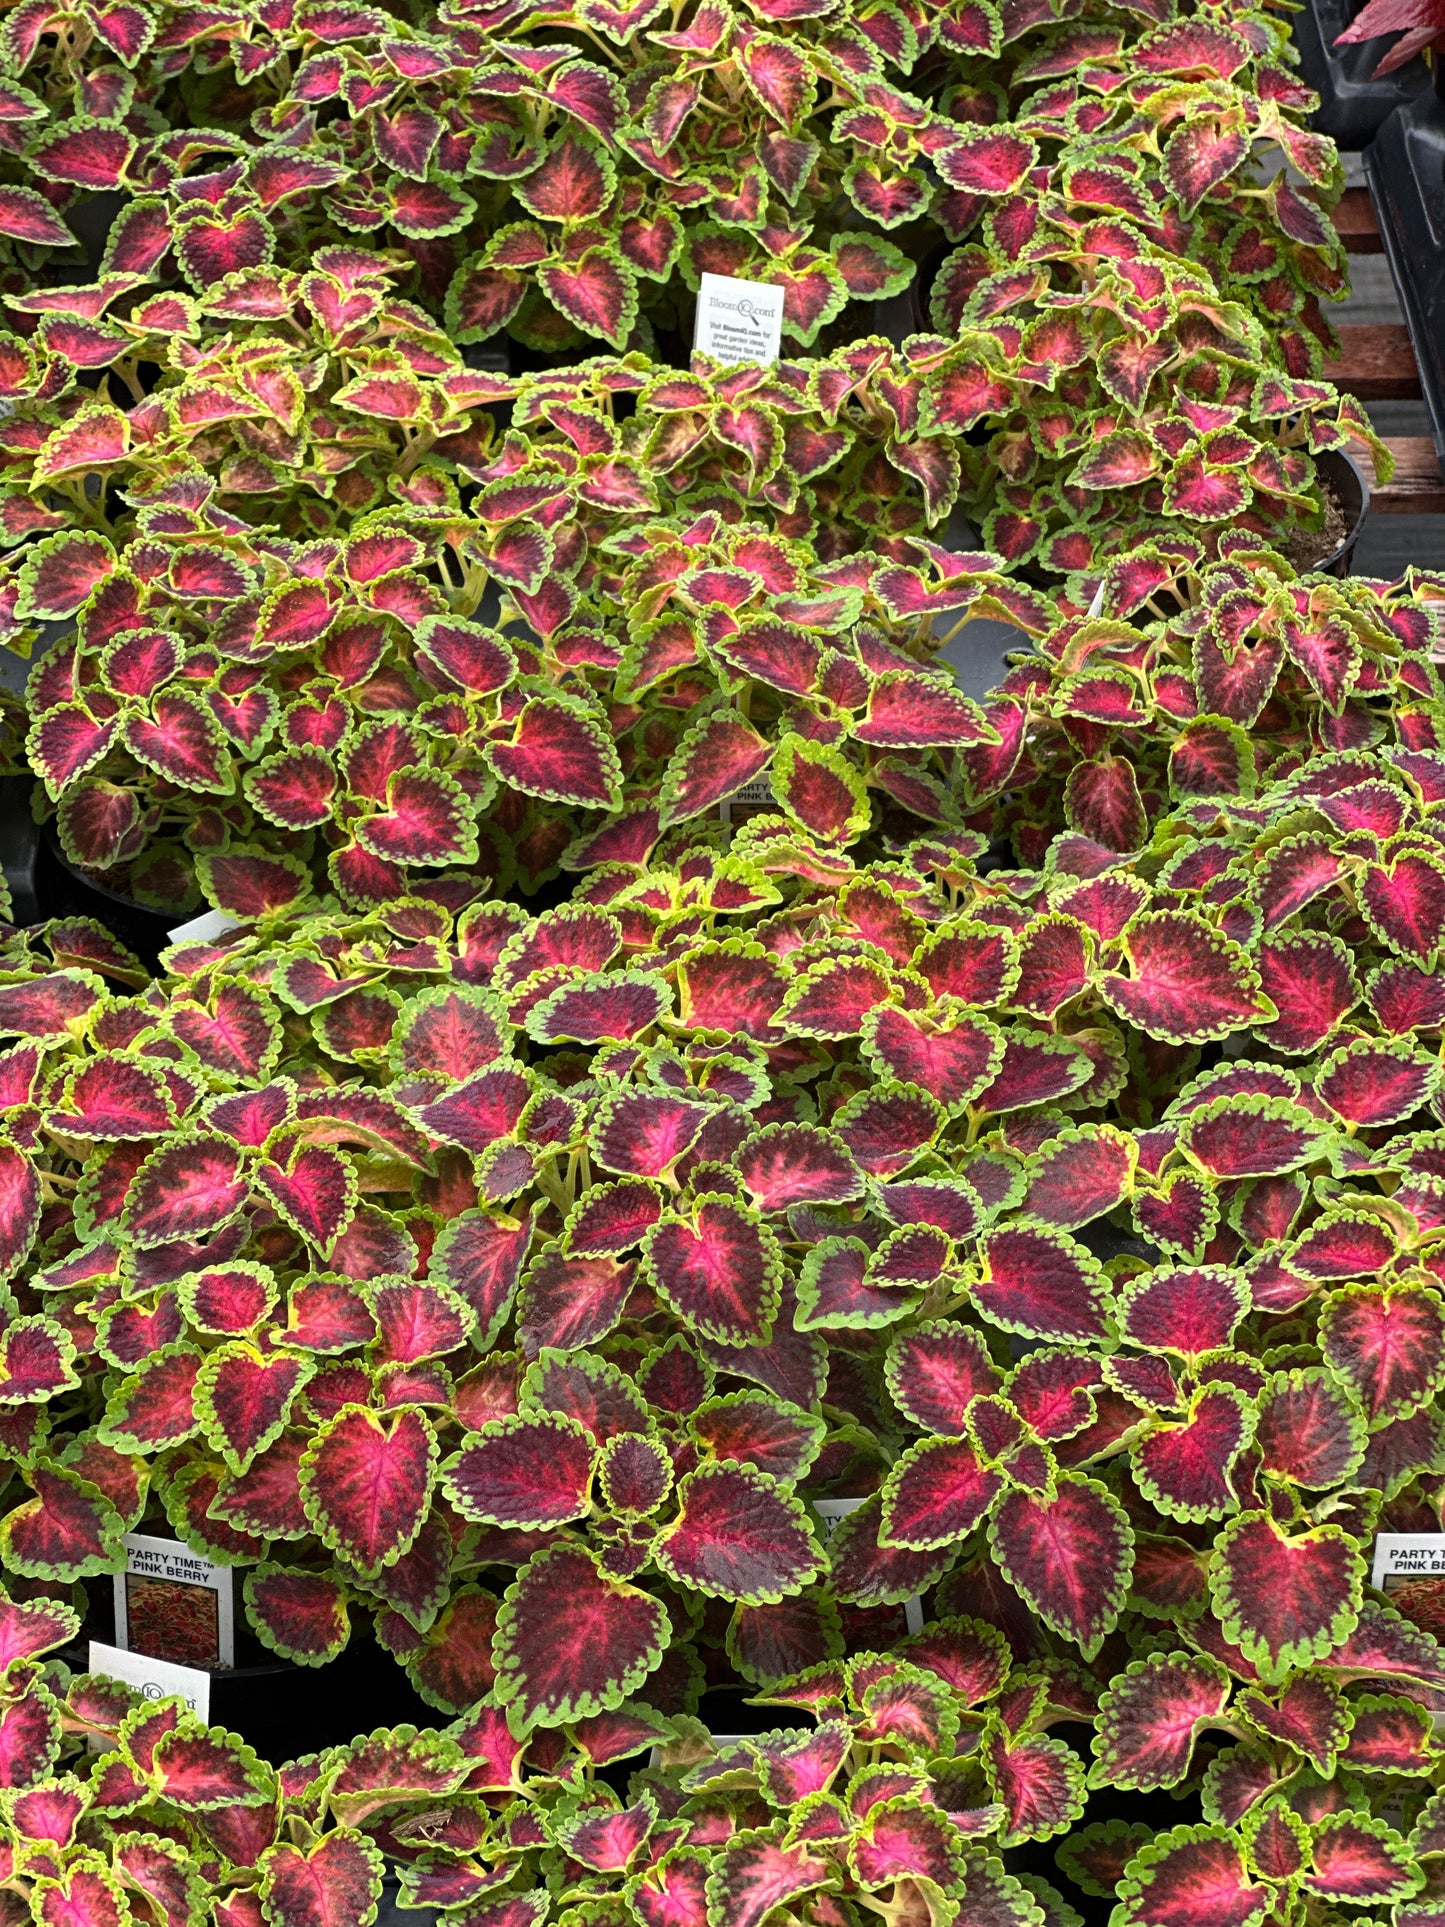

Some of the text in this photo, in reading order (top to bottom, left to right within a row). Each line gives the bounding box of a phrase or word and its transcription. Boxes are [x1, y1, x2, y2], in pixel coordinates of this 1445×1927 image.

[709, 321, 721, 330] Visit
[763, 331, 771, 339] for
[713, 333, 727, 341] great
[729, 335, 747, 344] garden
[712, 341, 766, 357] informative tips and
[718, 351, 736, 361] helpful
[737, 792, 762, 800] PINK
[127, 1548, 169, 1564] PARTY
[1389, 1549, 1437, 1559] PARTY
[1394, 1560, 1428, 1570] PINK
[133, 1560, 210, 1583] PINK BERRY
